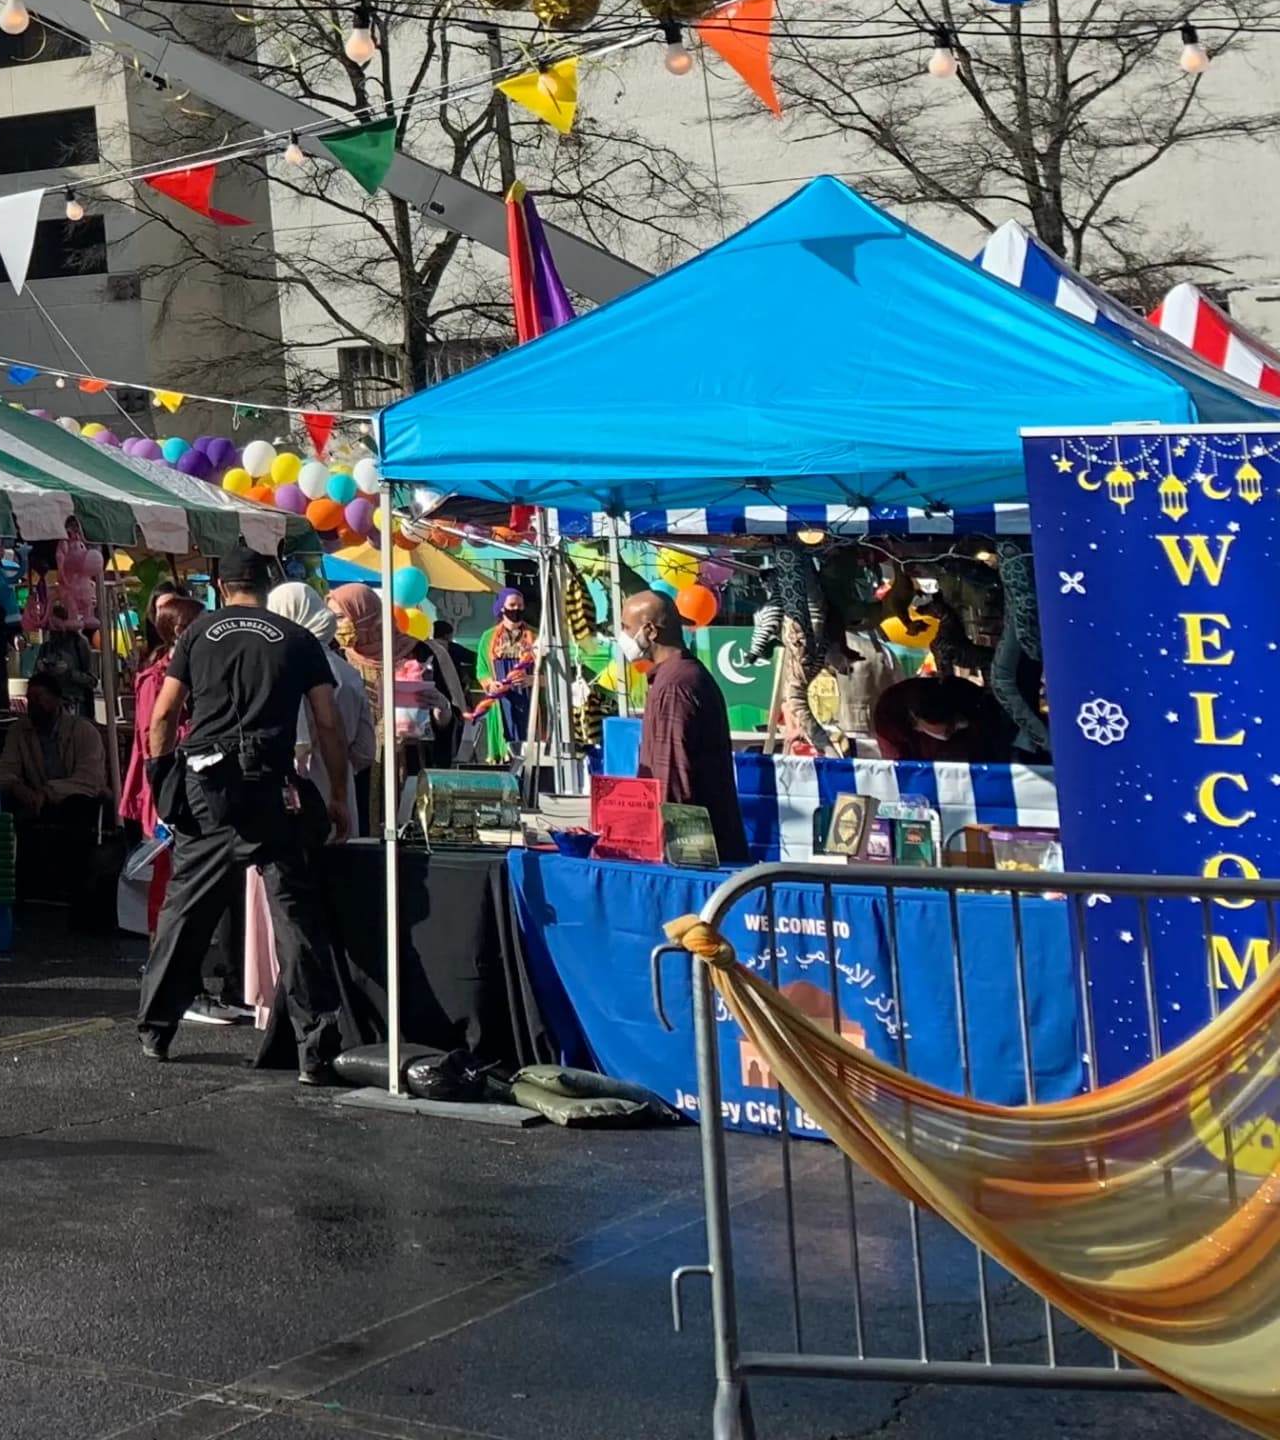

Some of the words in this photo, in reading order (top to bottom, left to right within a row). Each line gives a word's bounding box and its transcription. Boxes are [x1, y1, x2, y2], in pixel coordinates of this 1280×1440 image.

[212, 620, 238, 636] STILL
[239, 620, 278, 638] ROLLING
[1154, 534, 1280, 1074] WELCOM
[833, 920, 851, 939] TO
[675, 1088, 740, 1125] Jeey
[746, 1101, 785, 1132] City
